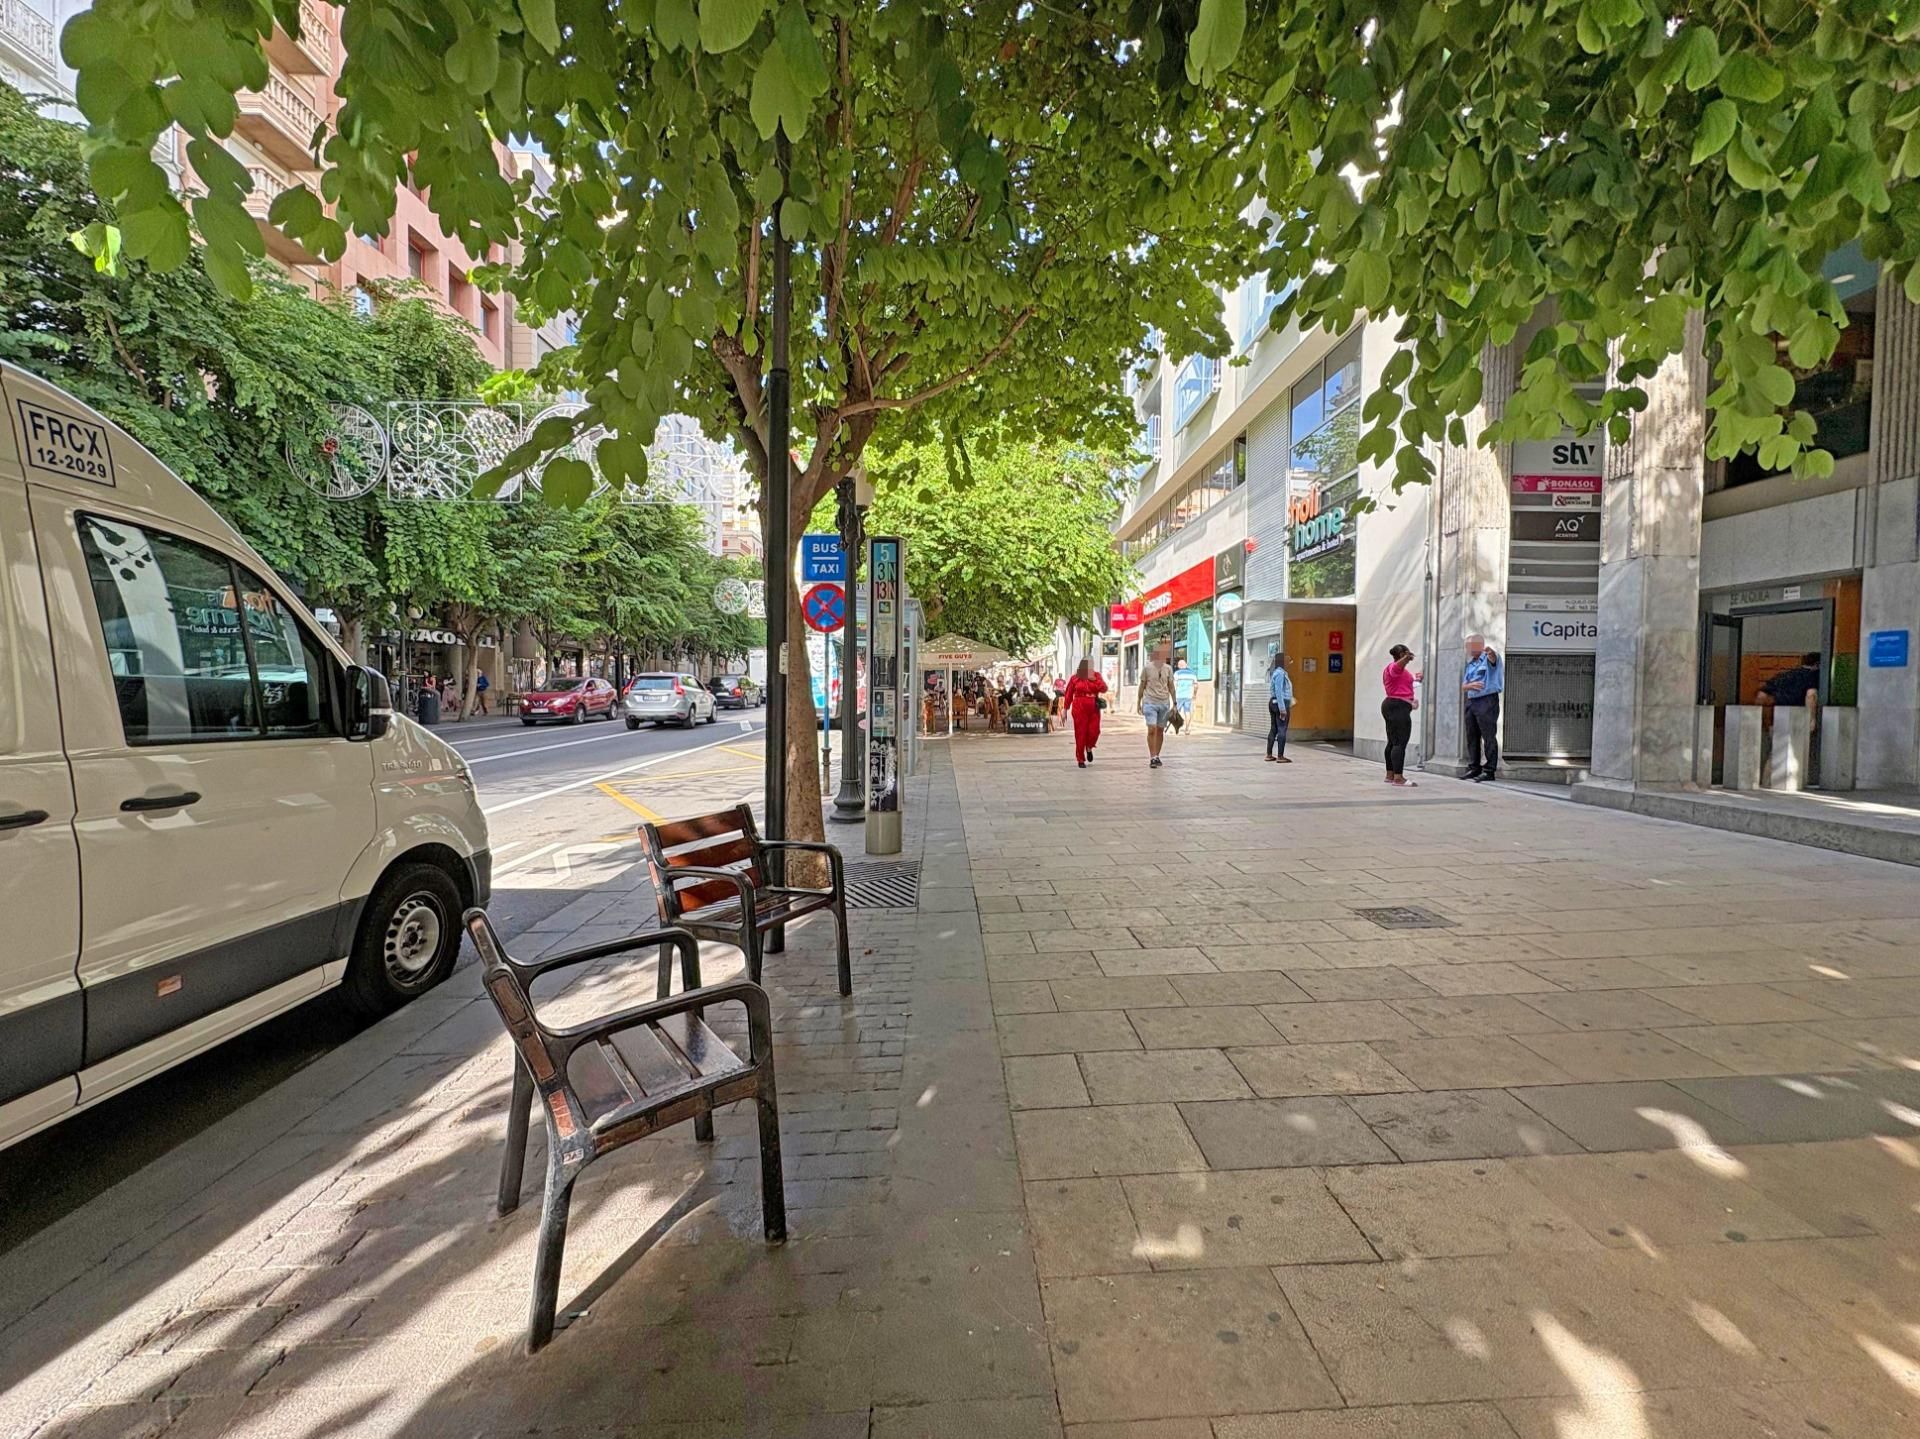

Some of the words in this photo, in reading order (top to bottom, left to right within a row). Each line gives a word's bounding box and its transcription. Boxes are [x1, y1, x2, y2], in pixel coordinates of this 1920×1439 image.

[29, 411, 103, 459] FRCX
[37, 447, 107, 479] 12-2029
[1551, 480, 1595, 488] BONASOL
[1288, 482, 1322, 528] holi
[1295, 507, 1346, 551] home
[1555, 519, 1579, 532] AQ
[812, 543, 838, 553] BUS
[880, 544, 889, 562] 5
[812, 563, 839, 574] TAXI
[1531, 620, 1598, 640] iCapita
